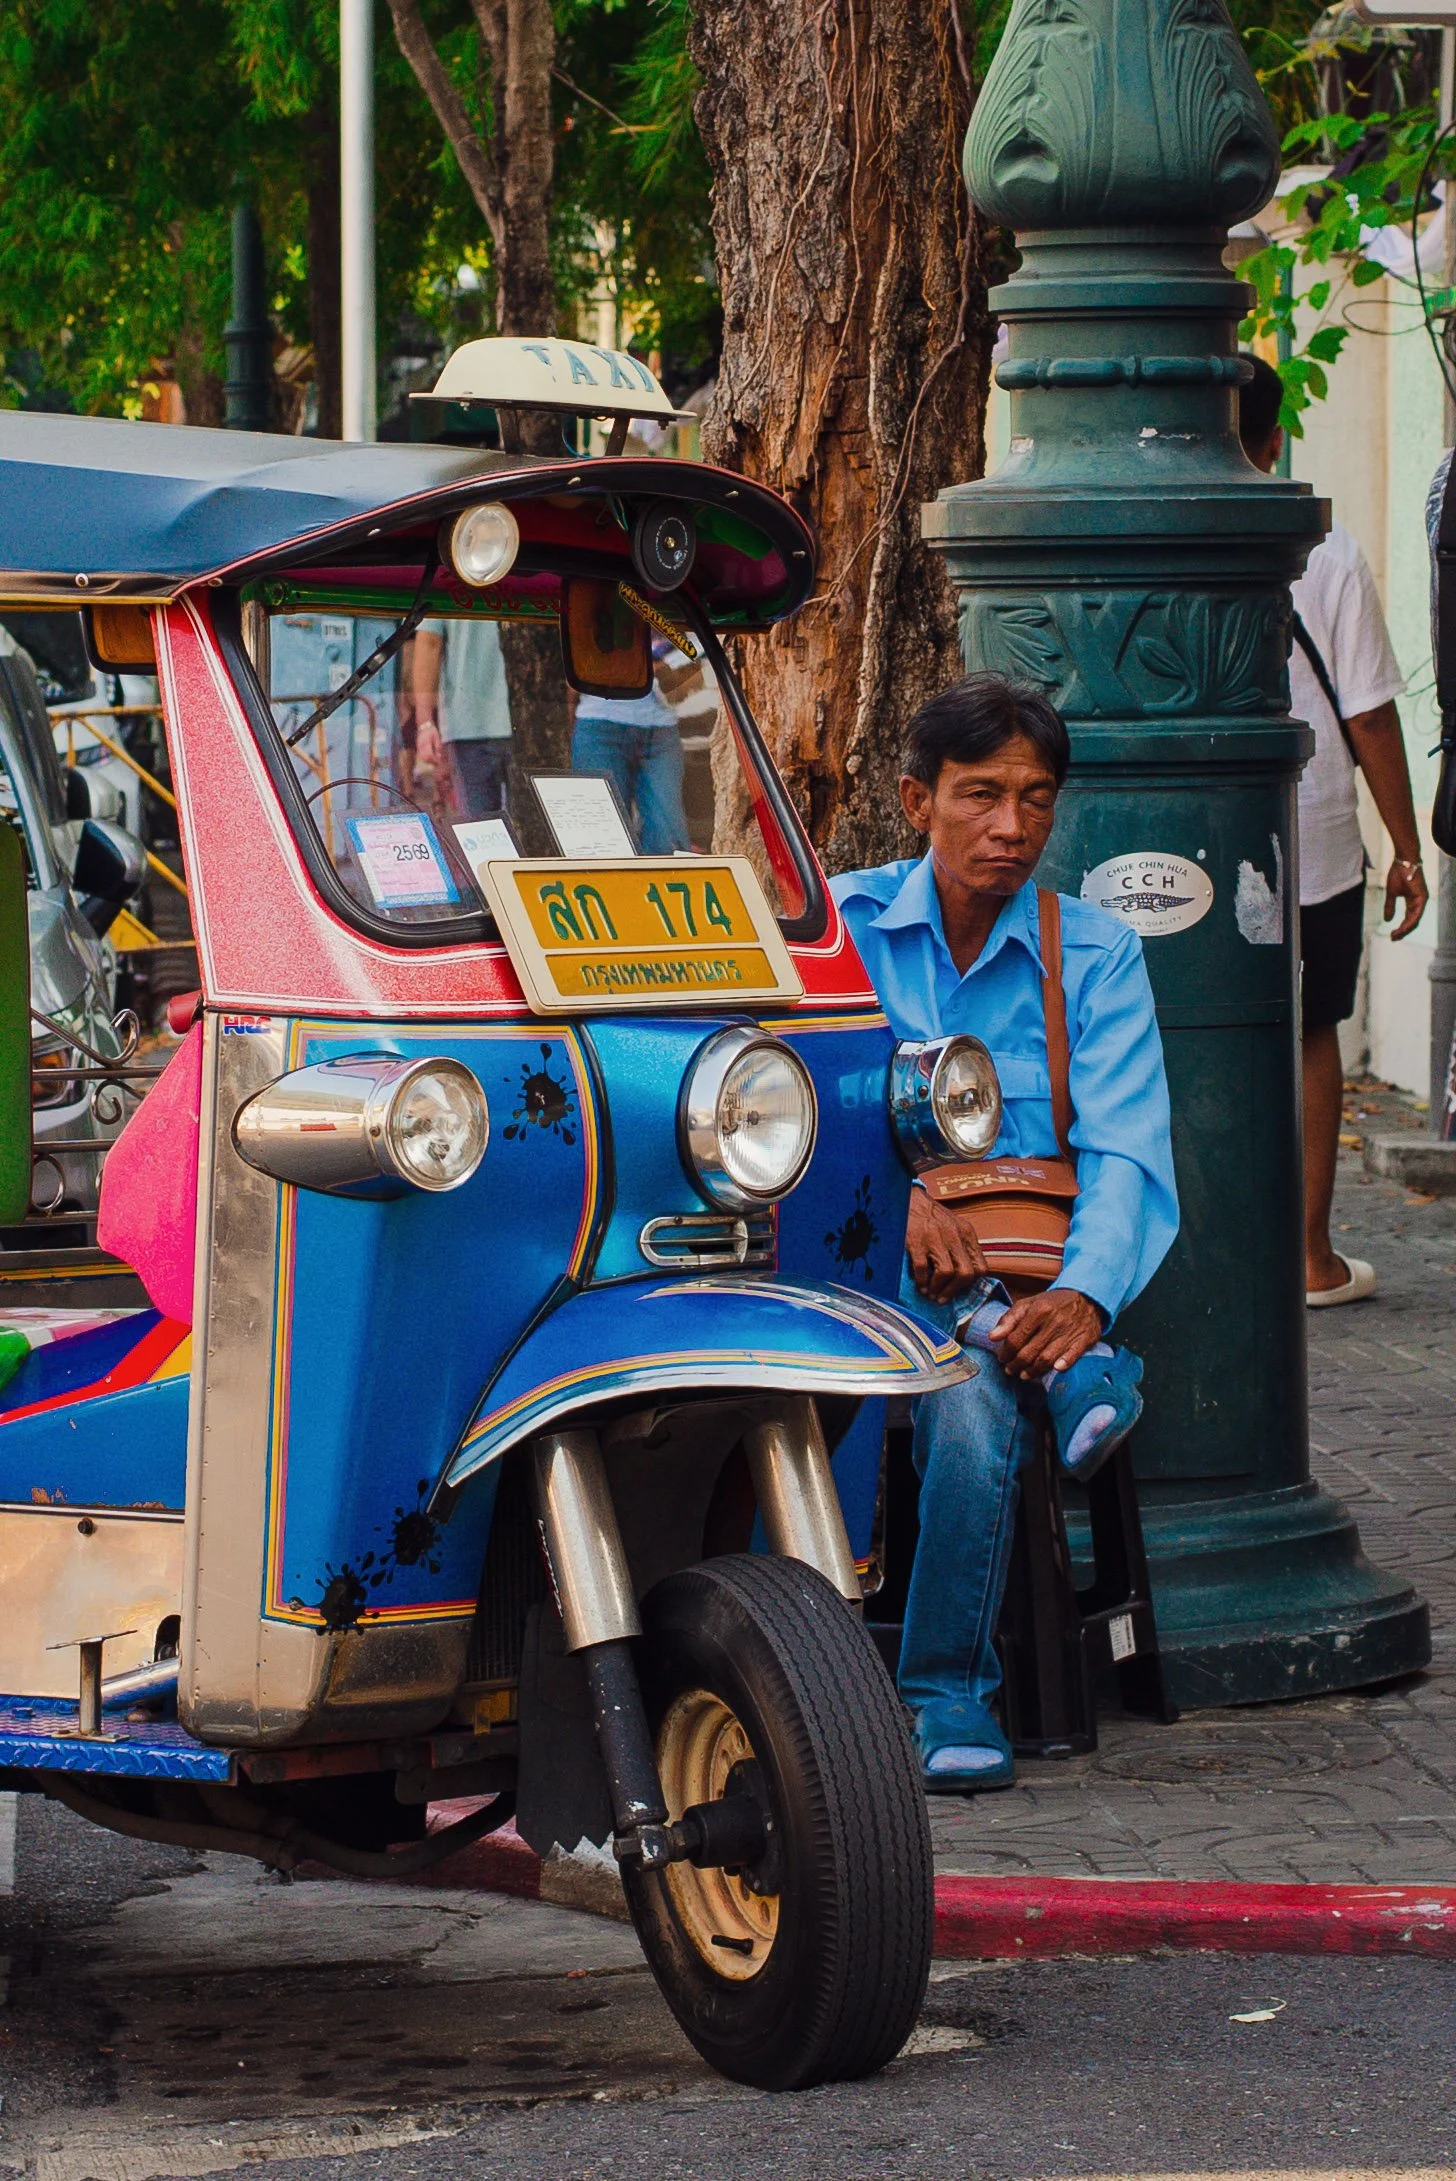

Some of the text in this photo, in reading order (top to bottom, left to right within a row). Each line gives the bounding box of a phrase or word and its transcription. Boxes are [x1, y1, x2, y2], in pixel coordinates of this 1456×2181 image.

[521, 344, 655, 393] TAXI
[393, 843, 430, 861] 2569
[1106, 861, 1188, 878] CHUE CHIN HUA
[538, 880, 734, 941] สก 174
[580, 959, 743, 995] กรุงเทพมหานคร
[223, 1015, 271, 1035] HRC
